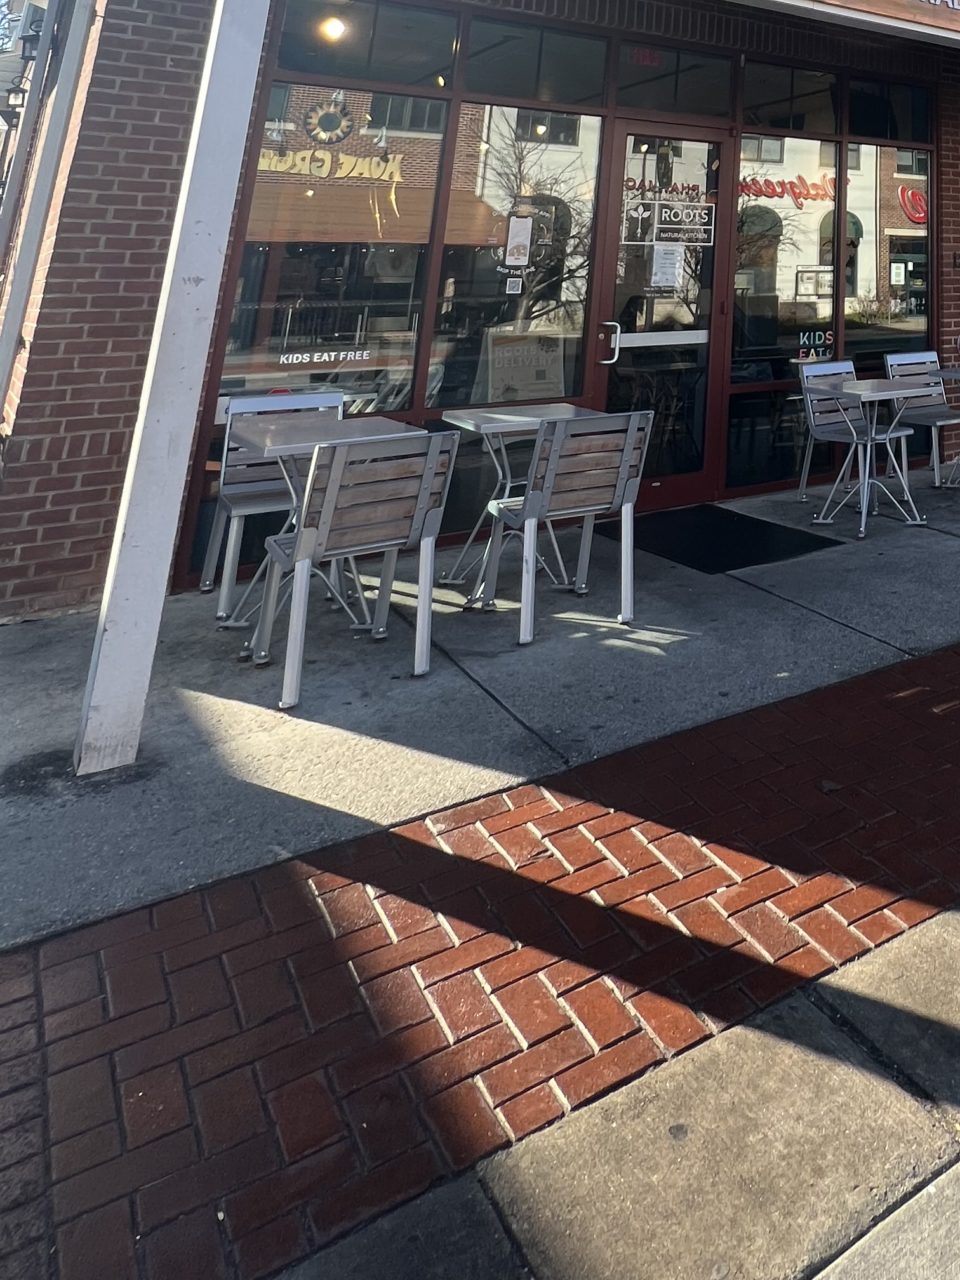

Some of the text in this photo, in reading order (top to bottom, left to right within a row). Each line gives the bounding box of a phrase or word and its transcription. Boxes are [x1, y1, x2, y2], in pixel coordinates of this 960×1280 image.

[661, 208, 709, 223] ROOTS
[660, 231, 684, 239] NATURAL
[799, 330, 834, 346] KIDS
[279, 349, 371, 364] KIDS EAT FREE
